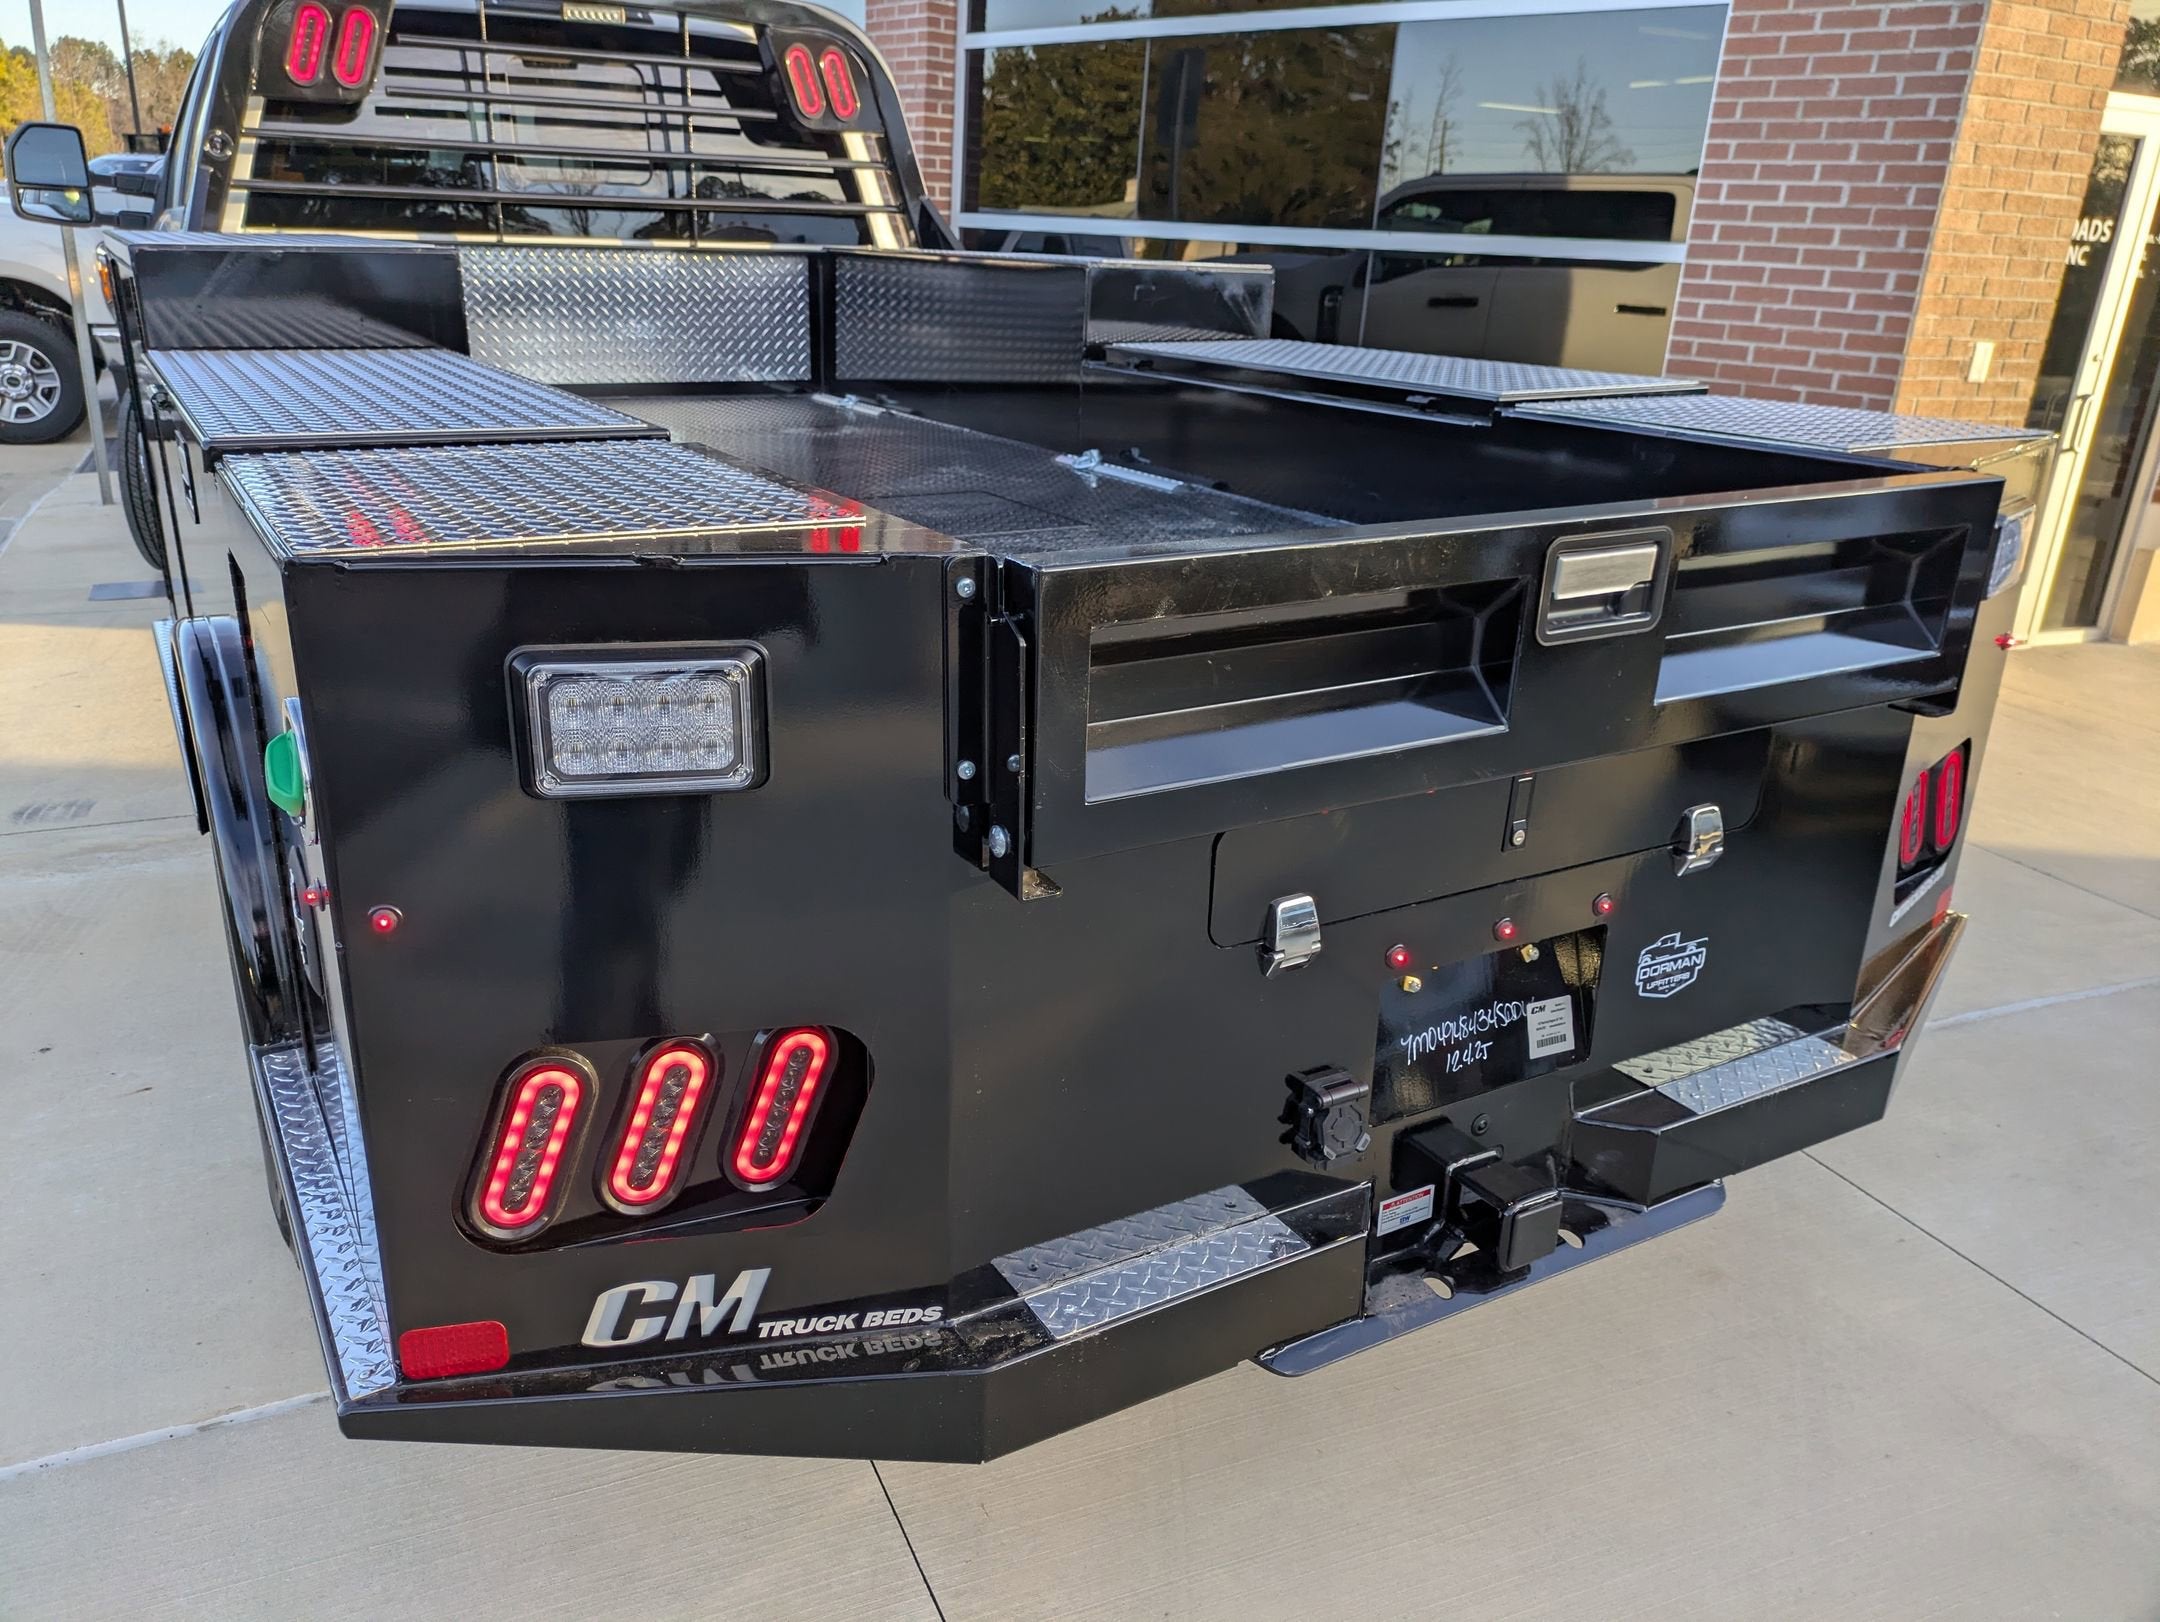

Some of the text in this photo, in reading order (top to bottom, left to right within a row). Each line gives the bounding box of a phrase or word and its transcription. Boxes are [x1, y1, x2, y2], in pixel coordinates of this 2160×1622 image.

[1639, 953, 1702, 980] DORMAN
[1646, 971, 1691, 990] UPFITTERS
[1531, 1005, 1546, 1014] CM
[580, 1267, 944, 1348] CM TRUCK BEDS
